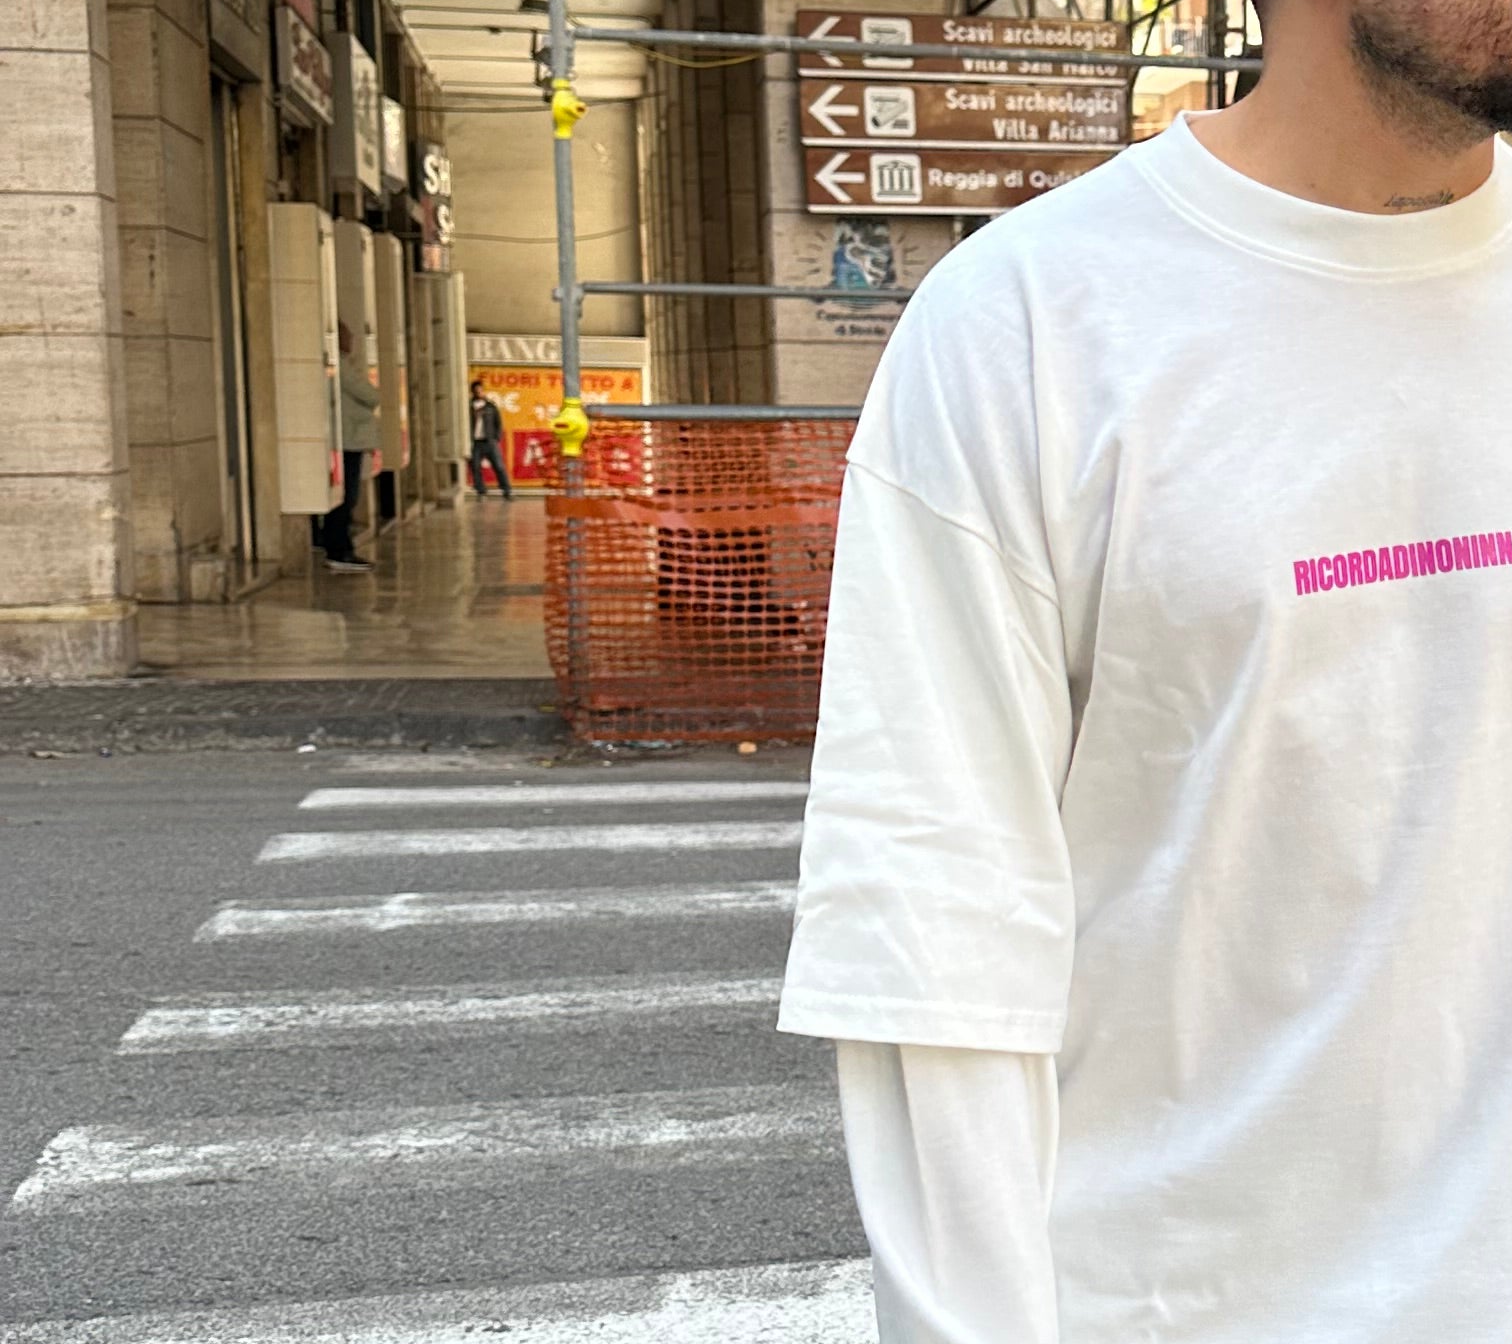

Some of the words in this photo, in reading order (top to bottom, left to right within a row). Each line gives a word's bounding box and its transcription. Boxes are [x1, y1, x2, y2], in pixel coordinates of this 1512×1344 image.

[943, 19, 994, 44] Scavi
[1003, 23, 1118, 52] archeologici
[945, 87, 996, 111] Scavi
[1005, 91, 1118, 118] archeologici
[992, 118, 1040, 142] Villa
[1048, 119, 1120, 143] Arianna
[927, 168, 998, 192] Reggia
[1003, 169, 1025, 189] di
